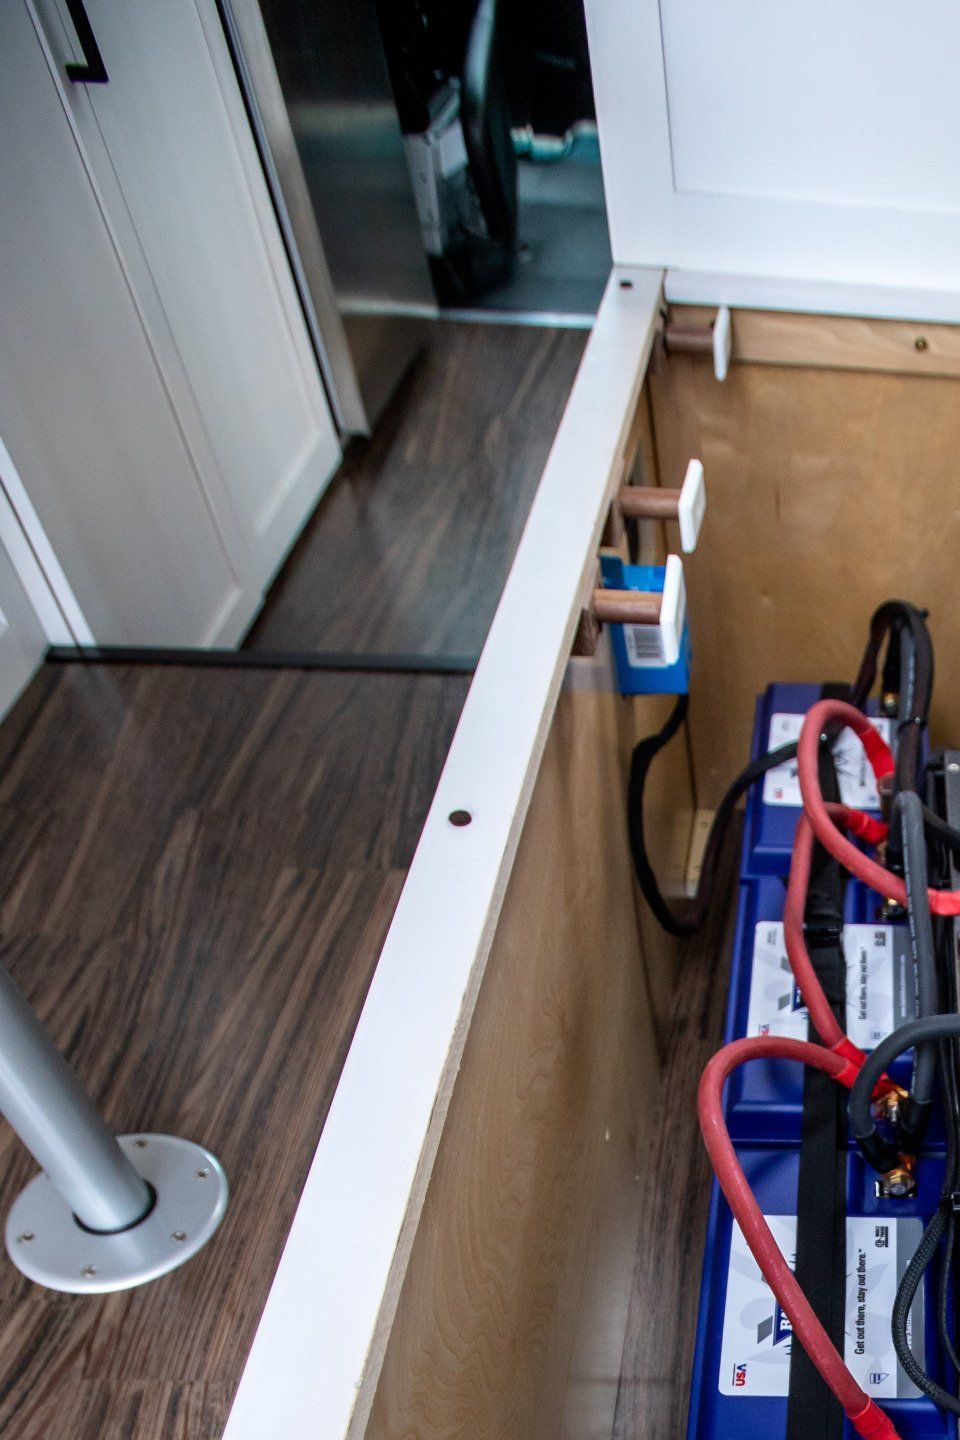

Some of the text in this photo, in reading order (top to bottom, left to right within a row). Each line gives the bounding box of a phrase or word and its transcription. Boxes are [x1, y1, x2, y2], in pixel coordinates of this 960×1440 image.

[857, 1274, 866, 1286] out
[857, 1287, 868, 1303] stay
[854, 1304, 866, 1326] there,
[855, 1327, 865, 1339] out
[854, 1341, 865, 1354] Get
[735, 1364, 746, 1387] USA
